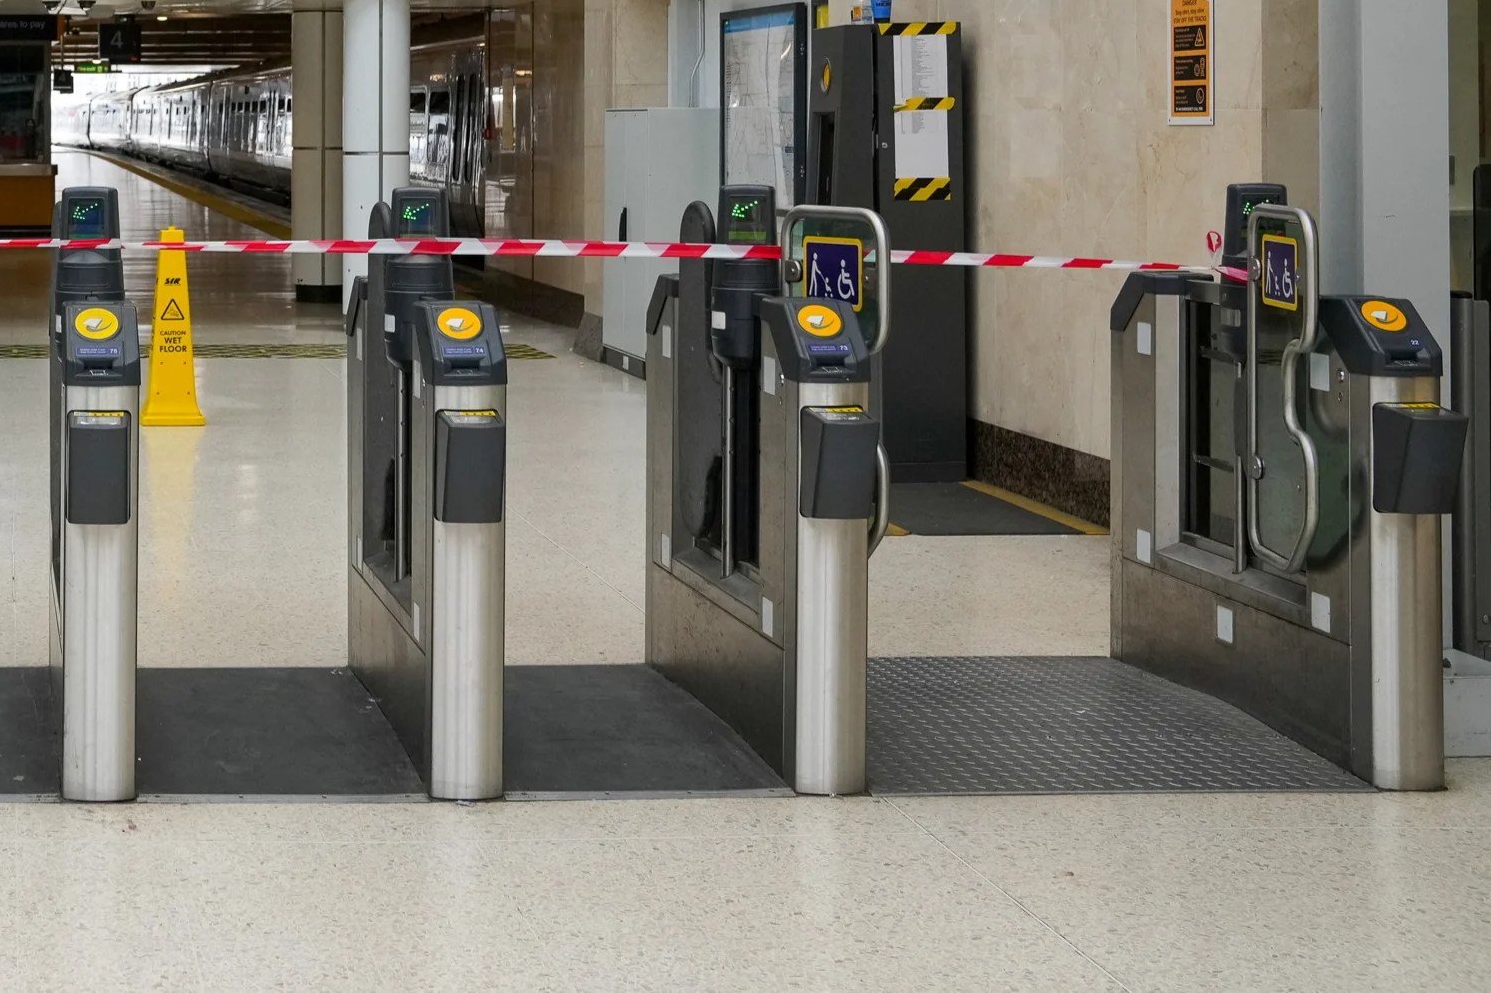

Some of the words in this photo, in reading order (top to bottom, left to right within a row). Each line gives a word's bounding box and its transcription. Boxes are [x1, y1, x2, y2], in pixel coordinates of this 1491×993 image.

[19, 19, 28, 30] to
[29, 20, 46, 31] pay
[110, 29, 123, 48] 4
